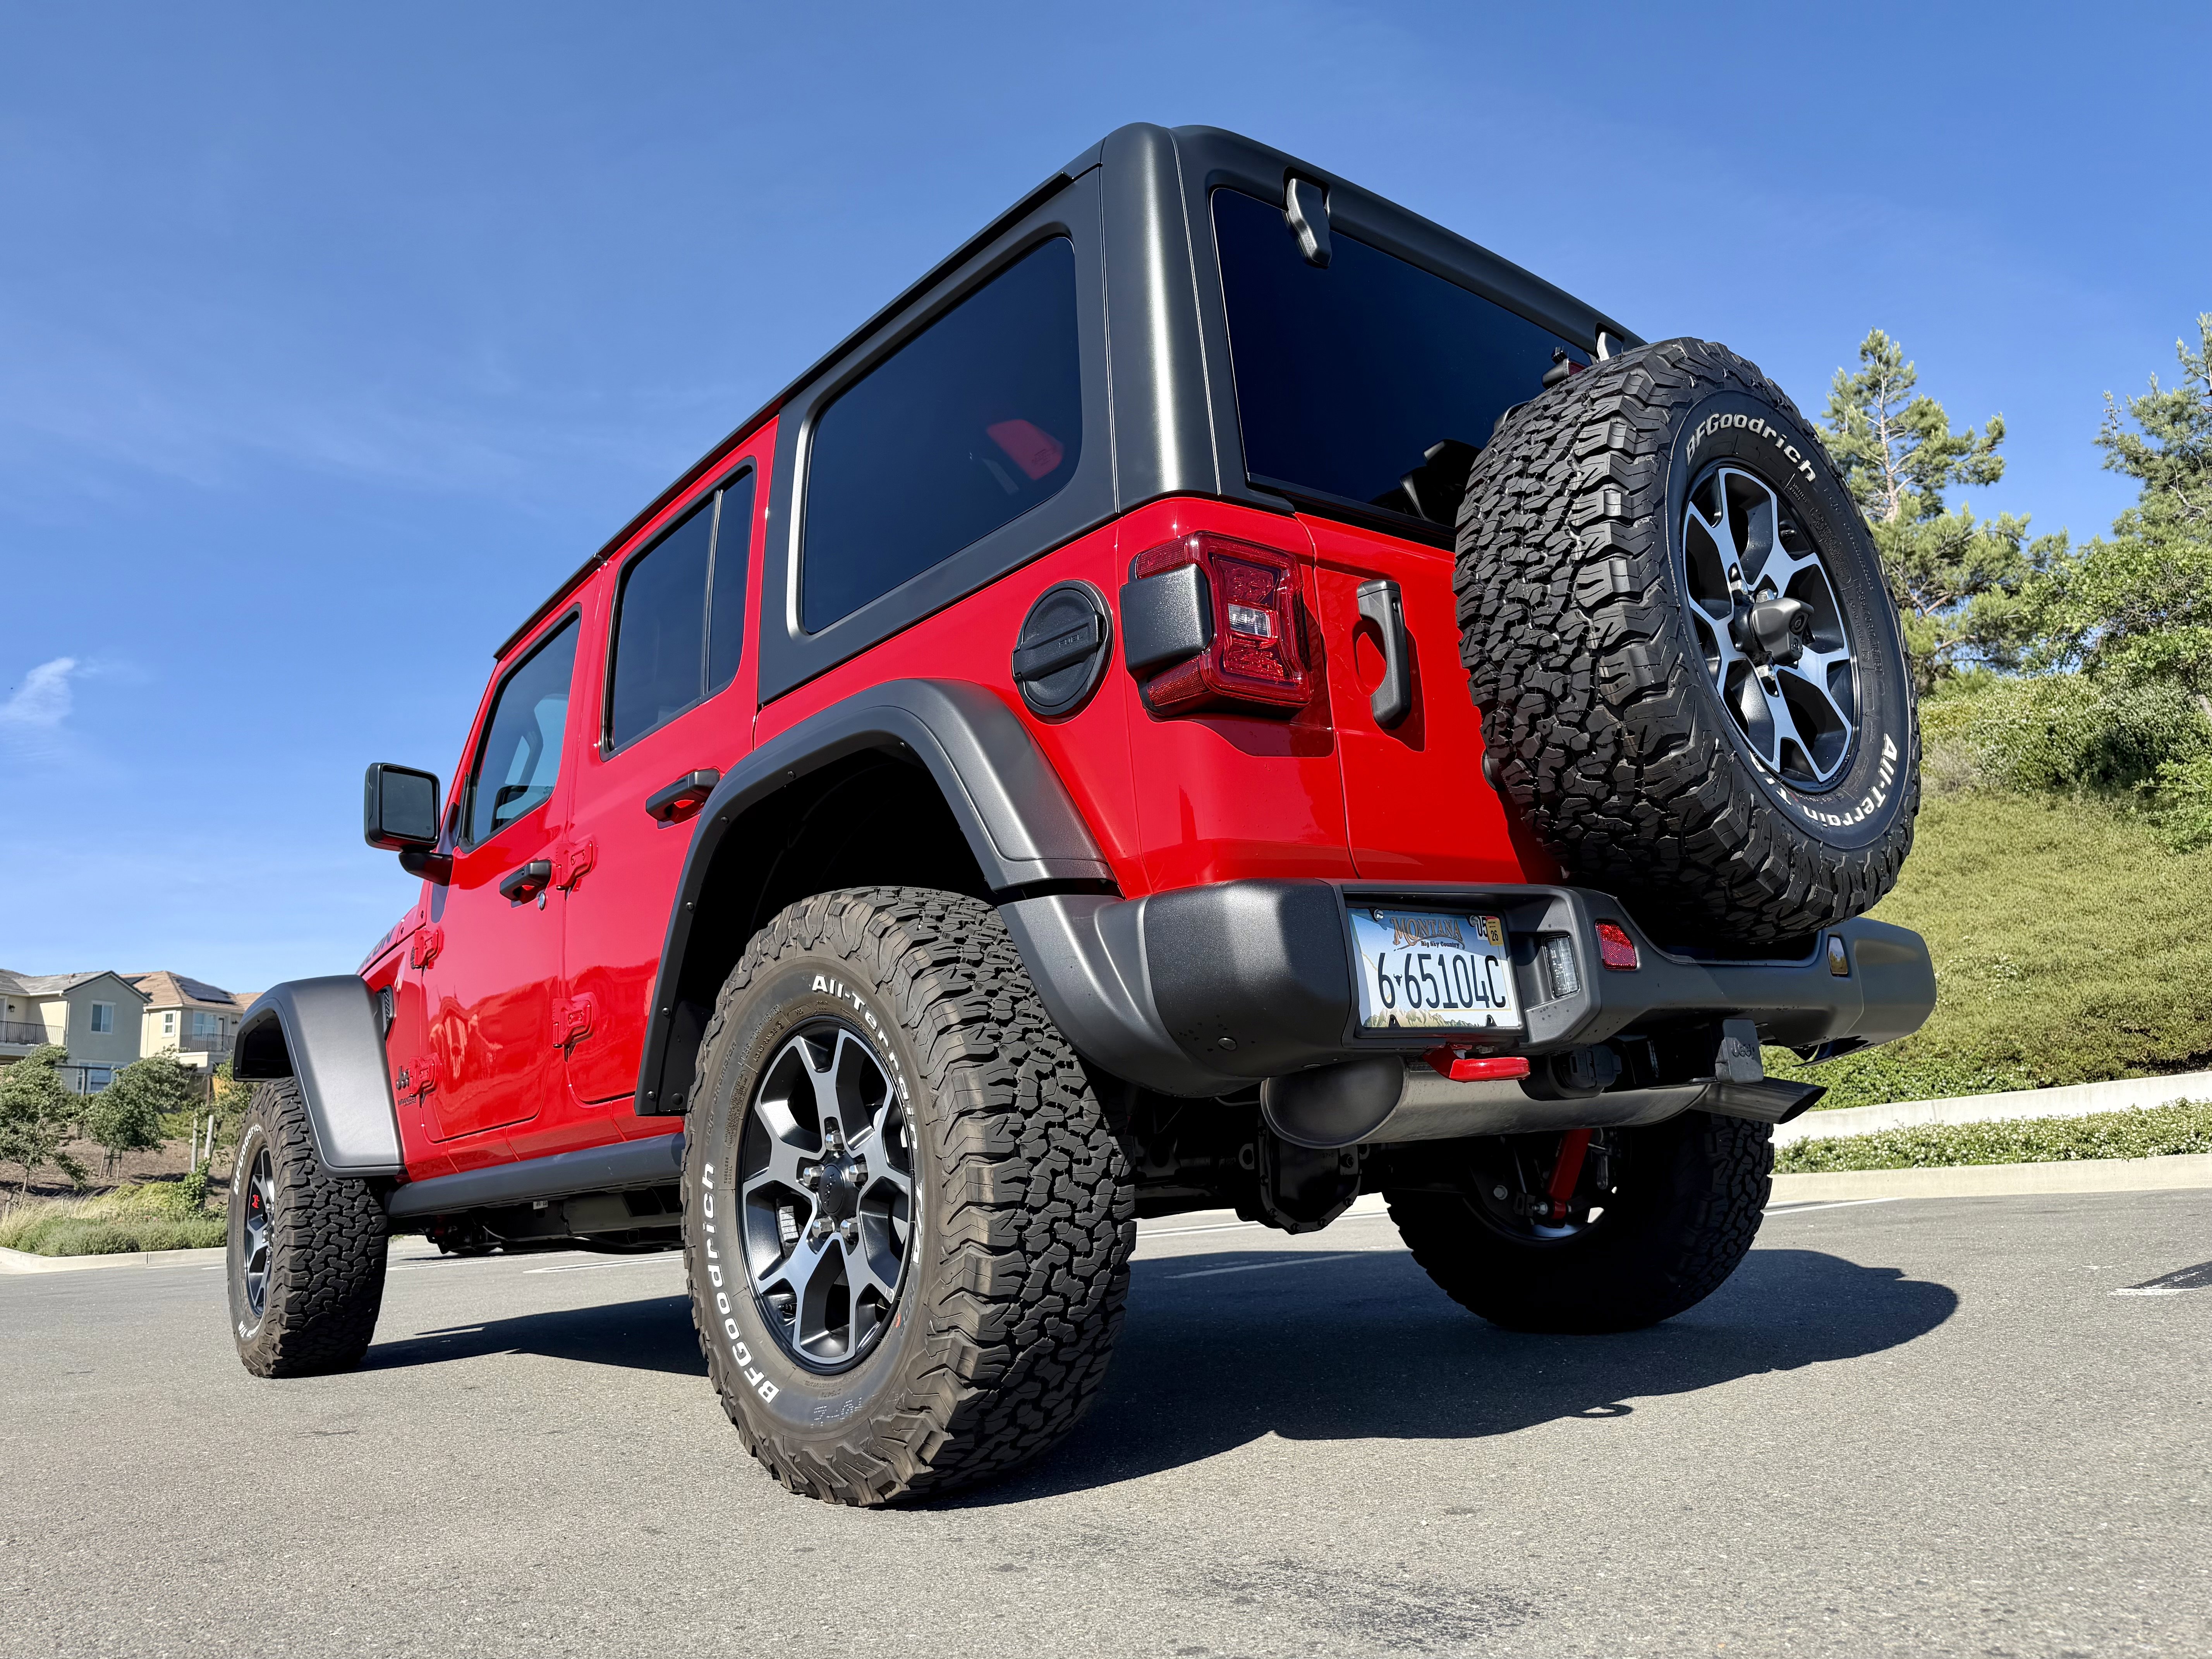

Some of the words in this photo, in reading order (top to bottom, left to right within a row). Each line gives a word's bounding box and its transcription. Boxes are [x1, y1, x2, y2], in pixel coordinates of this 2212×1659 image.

[1686, 413, 1816, 482] BFGoodrich
[1058, 633, 1084, 648] FUEL
[1803, 733, 1898, 827] All-Terrain
[1390, 916, 1463, 945] MONTANA
[1491, 930, 1499, 941] 26
[753, 1045, 764, 1062] LOAD
[763, 1028, 778, 1044] RANGE
[812, 975, 918, 1151] All-Terrain
[912, 1182, 923, 1264] T/A
[234, 1124, 262, 1195] BFGoodrich
[702, 1162, 780, 1404] BFGoodrich
